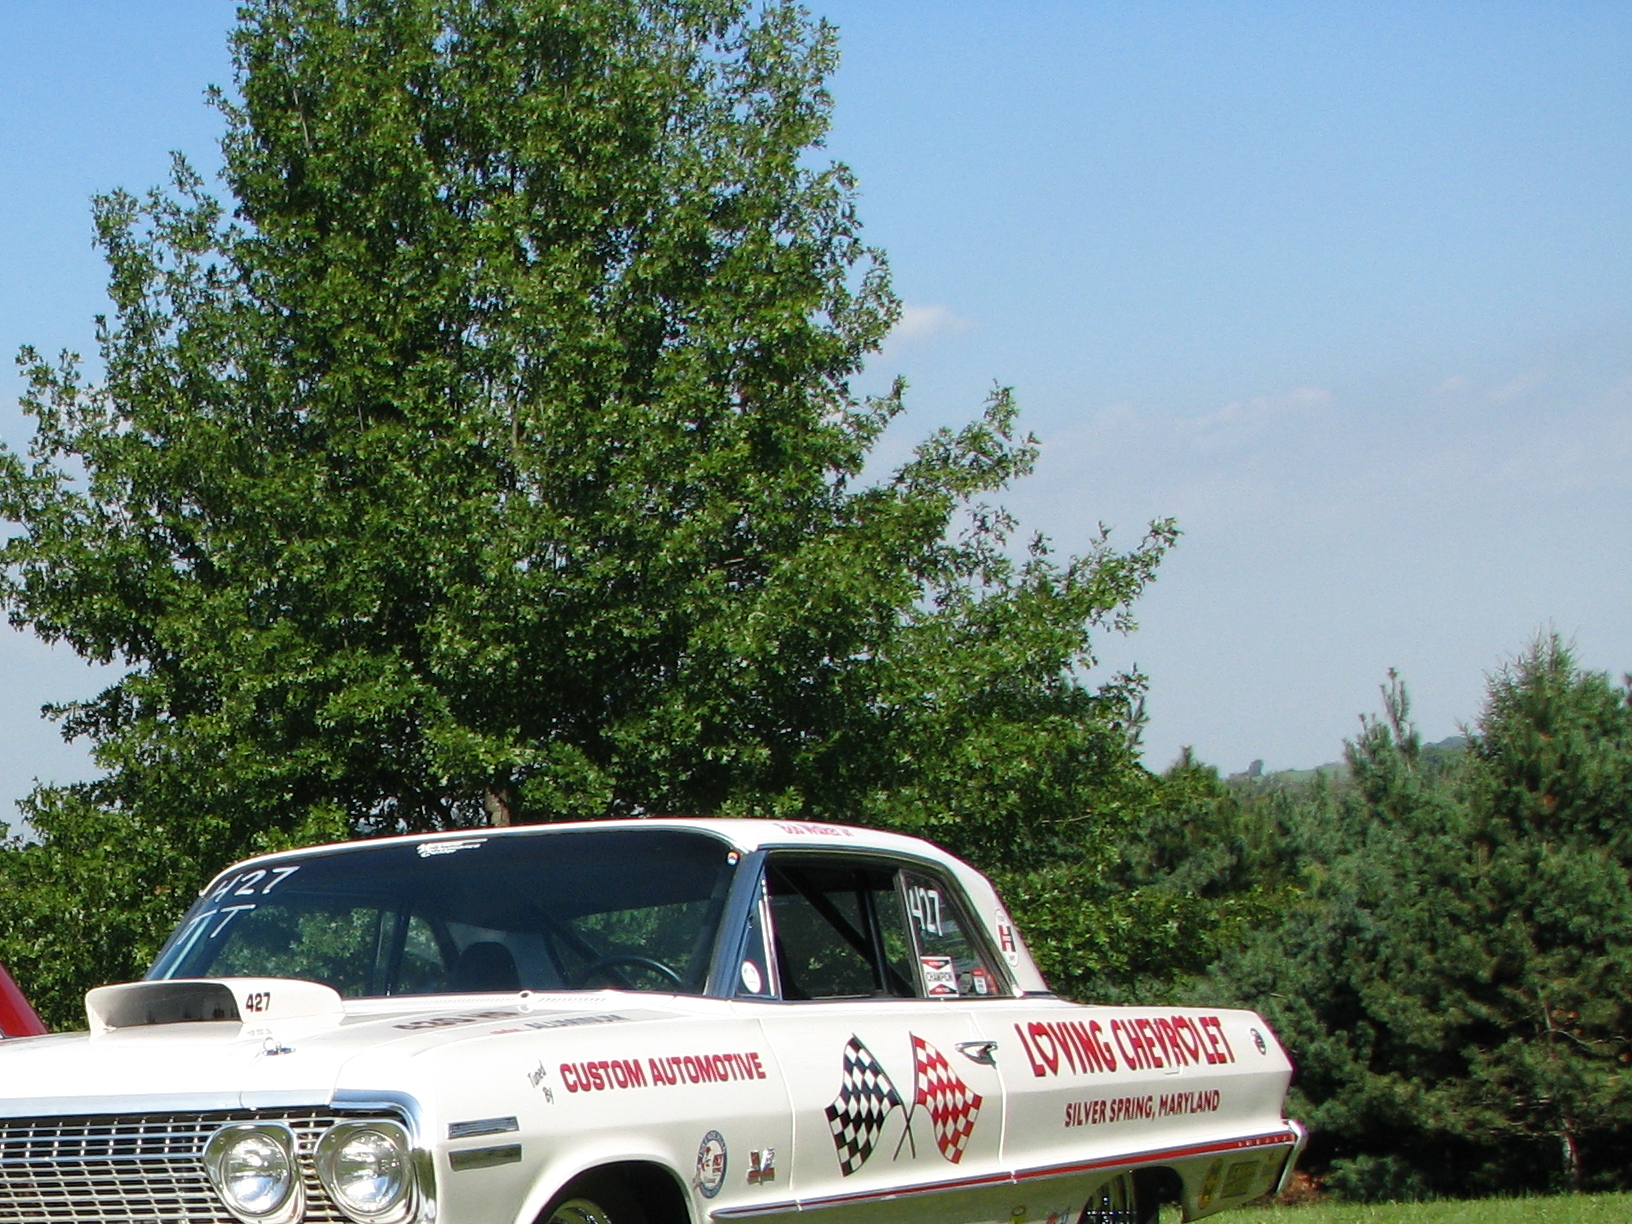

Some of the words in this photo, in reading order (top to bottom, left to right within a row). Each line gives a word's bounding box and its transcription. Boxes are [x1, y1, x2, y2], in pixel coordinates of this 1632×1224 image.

[909, 886, 943, 937] 427
[246, 991, 271, 1013] 427
[1013, 1019, 1117, 1078] LOVING
[1110, 1015, 1236, 1071] CHEVROLET
[527, 1059, 547, 1088] Tuned
[559, 1059, 648, 1093] CUSTOM
[648, 1052, 767, 1087] AUTOMOTIVE
[1064, 1099, 1106, 1127] SILVER
[1109, 1095, 1156, 1121] SPRING,
[1158, 1089, 1221, 1116] MARYLAND
